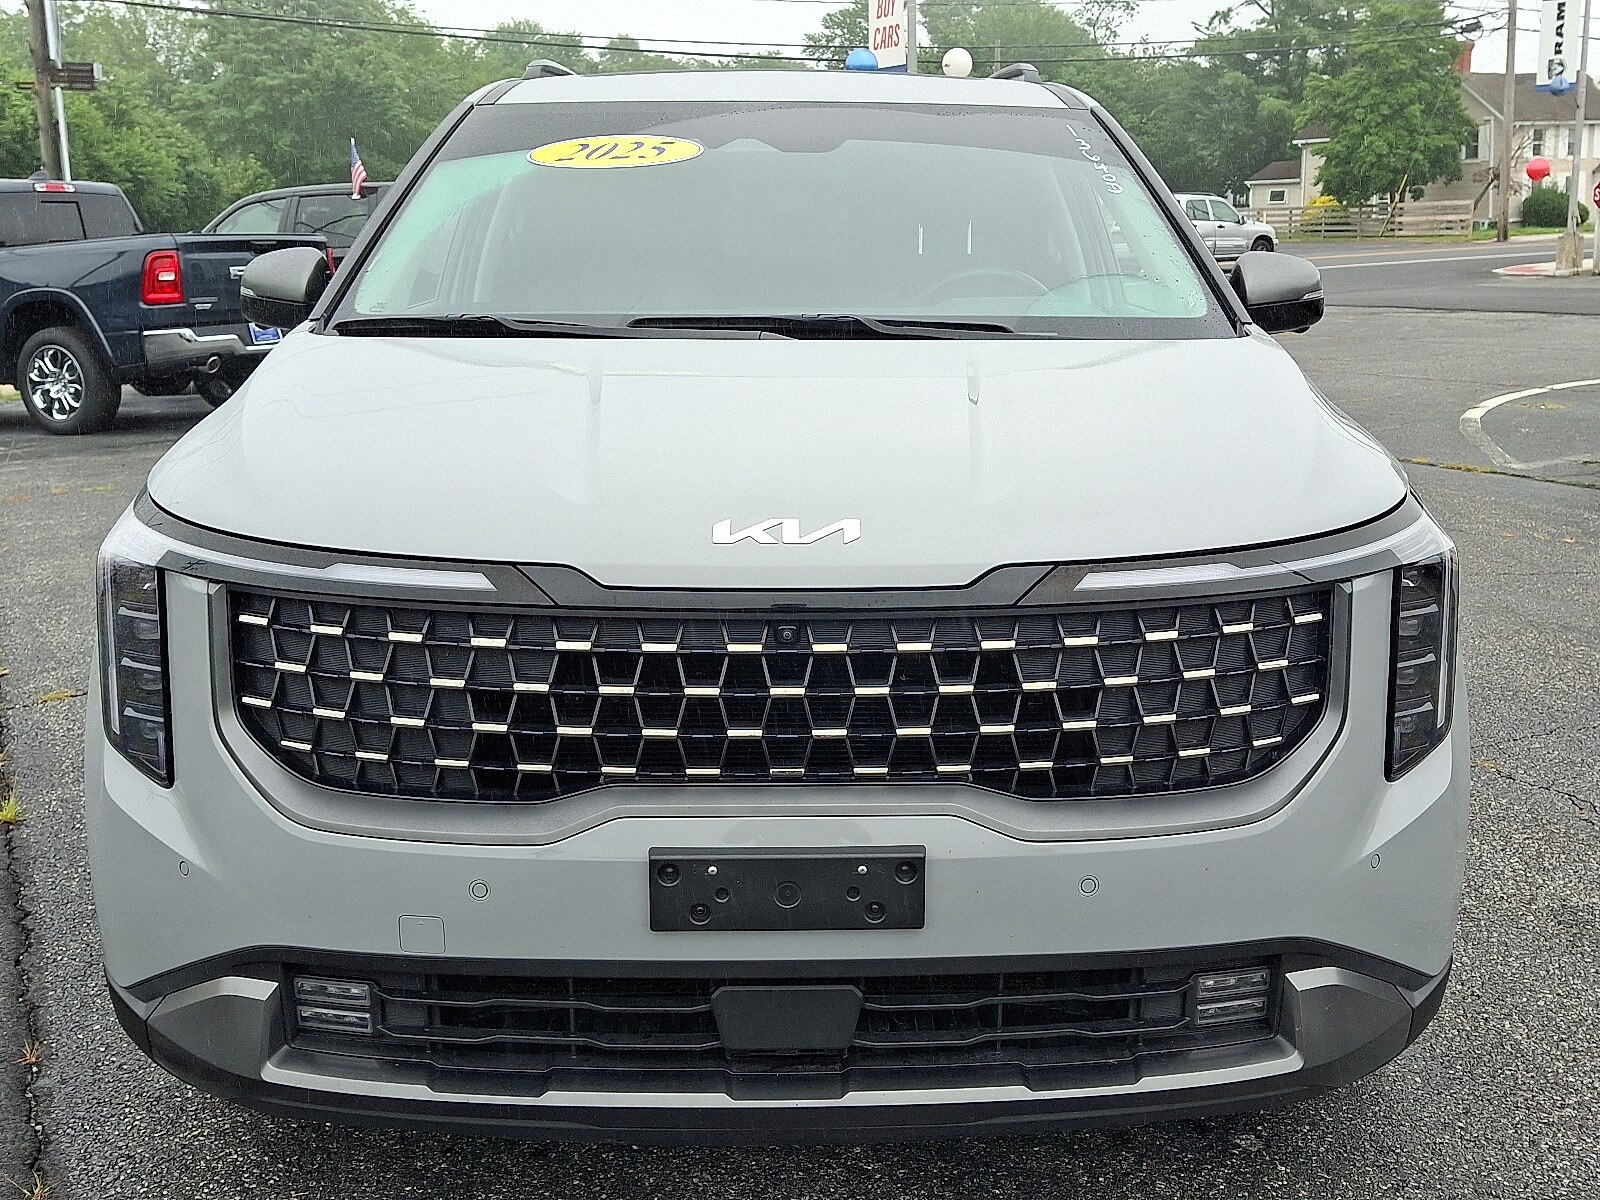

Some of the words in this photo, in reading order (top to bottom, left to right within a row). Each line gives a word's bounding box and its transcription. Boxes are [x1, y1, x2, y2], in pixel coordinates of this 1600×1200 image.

[873, 23, 900, 50] CARS
[1554, 2, 1566, 55] RAM
[554, 141, 676, 162] 2025
[712, 518, 861, 545] KIA
